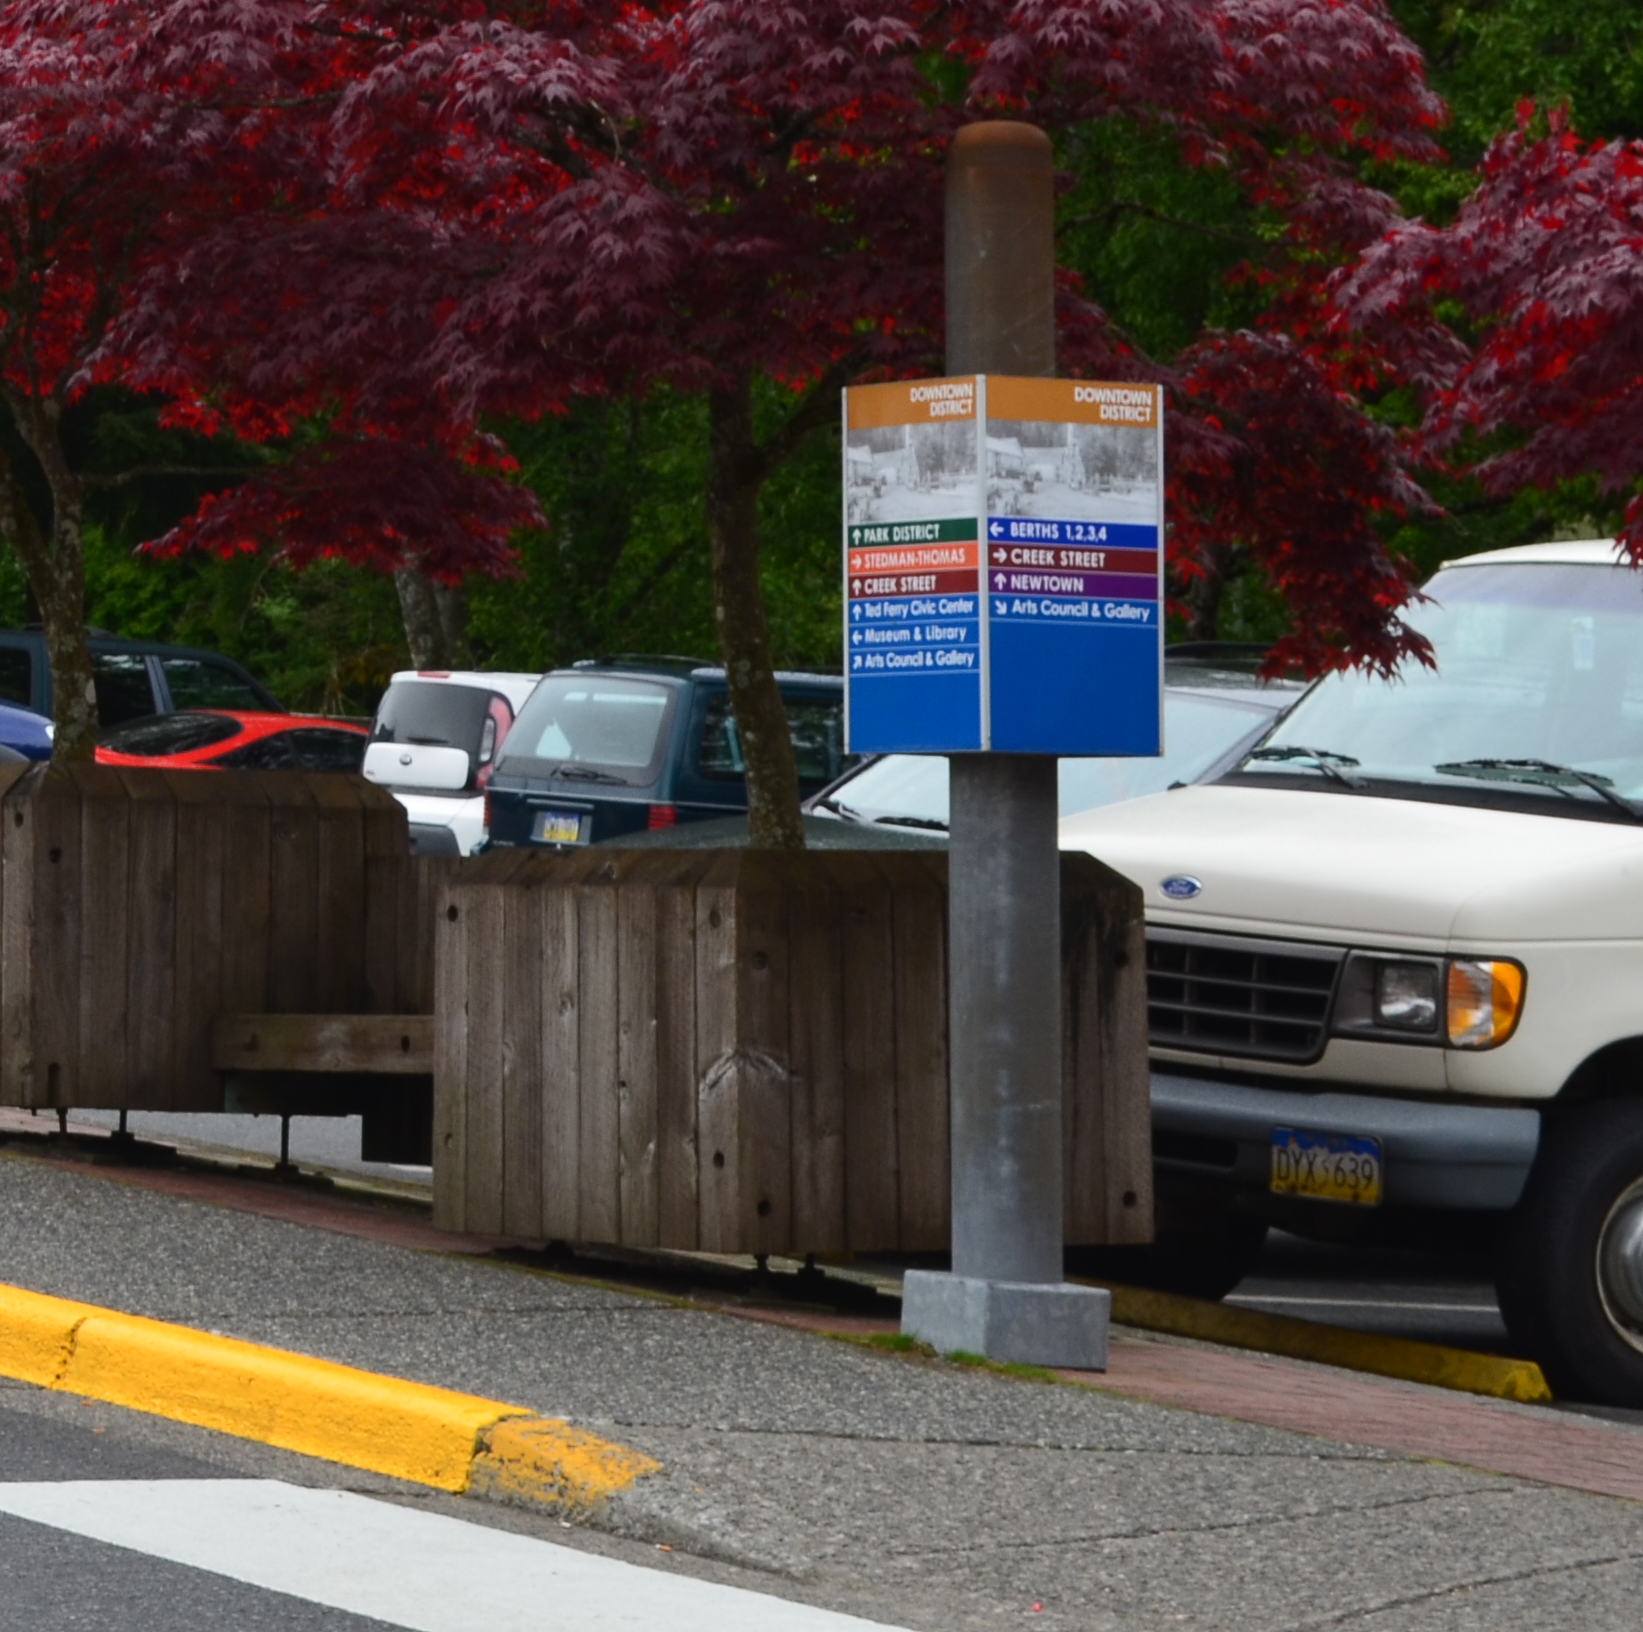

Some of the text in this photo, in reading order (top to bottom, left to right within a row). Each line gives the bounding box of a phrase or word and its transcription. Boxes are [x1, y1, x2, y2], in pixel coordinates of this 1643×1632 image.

[910, 383, 973, 402] DOWNTOWN
[1074, 386, 1152, 405] DOWNTOWN
[930, 399, 972, 417] DISTRICT
[1100, 404, 1151, 422] DISTRICT
[864, 524, 940, 543] PARK DISTRICT
[1010, 521, 1107, 542] BERTHS 1,2,3,4
[865, 548, 965, 569] STEDMAN-THOMAS
[1010, 548, 1106, 568] CREEK STREET
[864, 575, 936, 594] CREEK STREET
[1010, 574, 1084, 592] NEWTOWN
[865, 598, 974, 619] Ted Ferry Civic Center
[1012, 599, 1150, 623] Arts Council & Gallery
[865, 625, 967, 643] Museum & Library
[865, 649, 975, 668] Arts Council & Gallery
